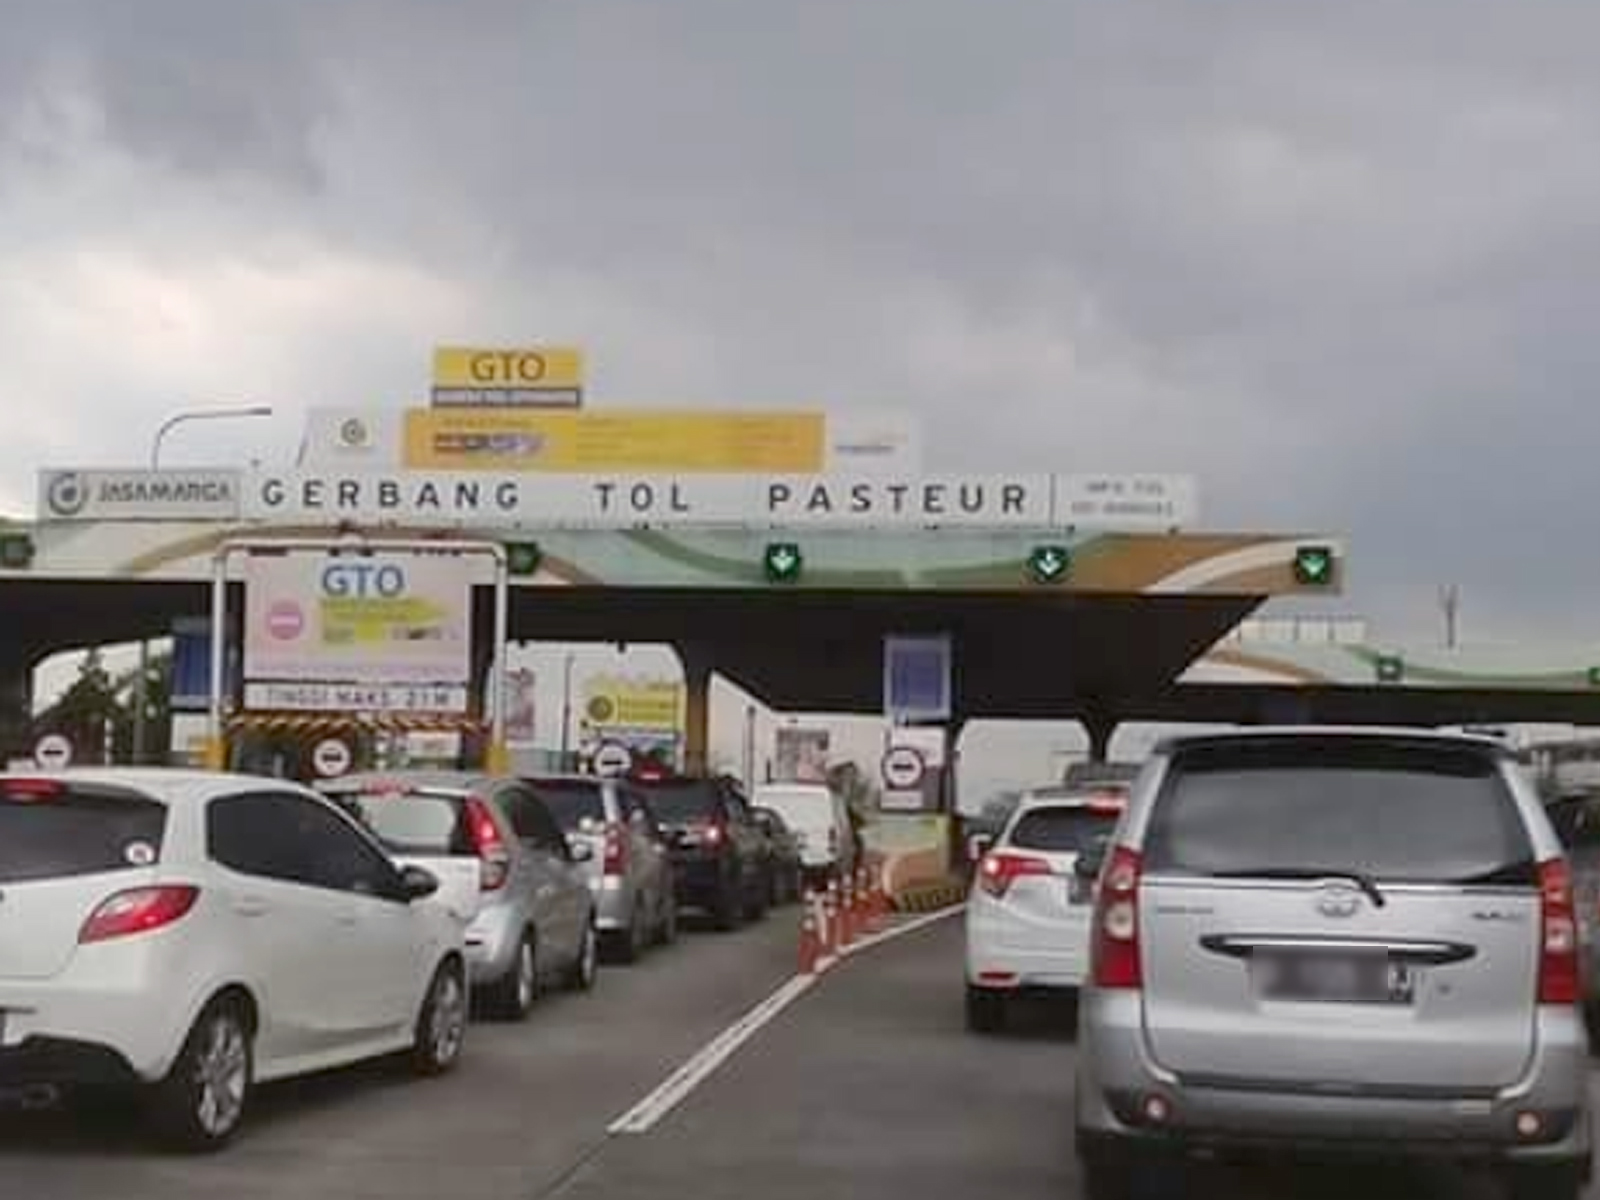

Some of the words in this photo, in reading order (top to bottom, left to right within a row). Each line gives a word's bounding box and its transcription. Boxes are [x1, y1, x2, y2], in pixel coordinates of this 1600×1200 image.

[470, 352, 546, 381] GTO
[261, 479, 520, 508] GERBANG
[595, 483, 690, 511] TOL
[768, 484, 1028, 513] PASTEUR
[322, 564, 405, 597] GTO
